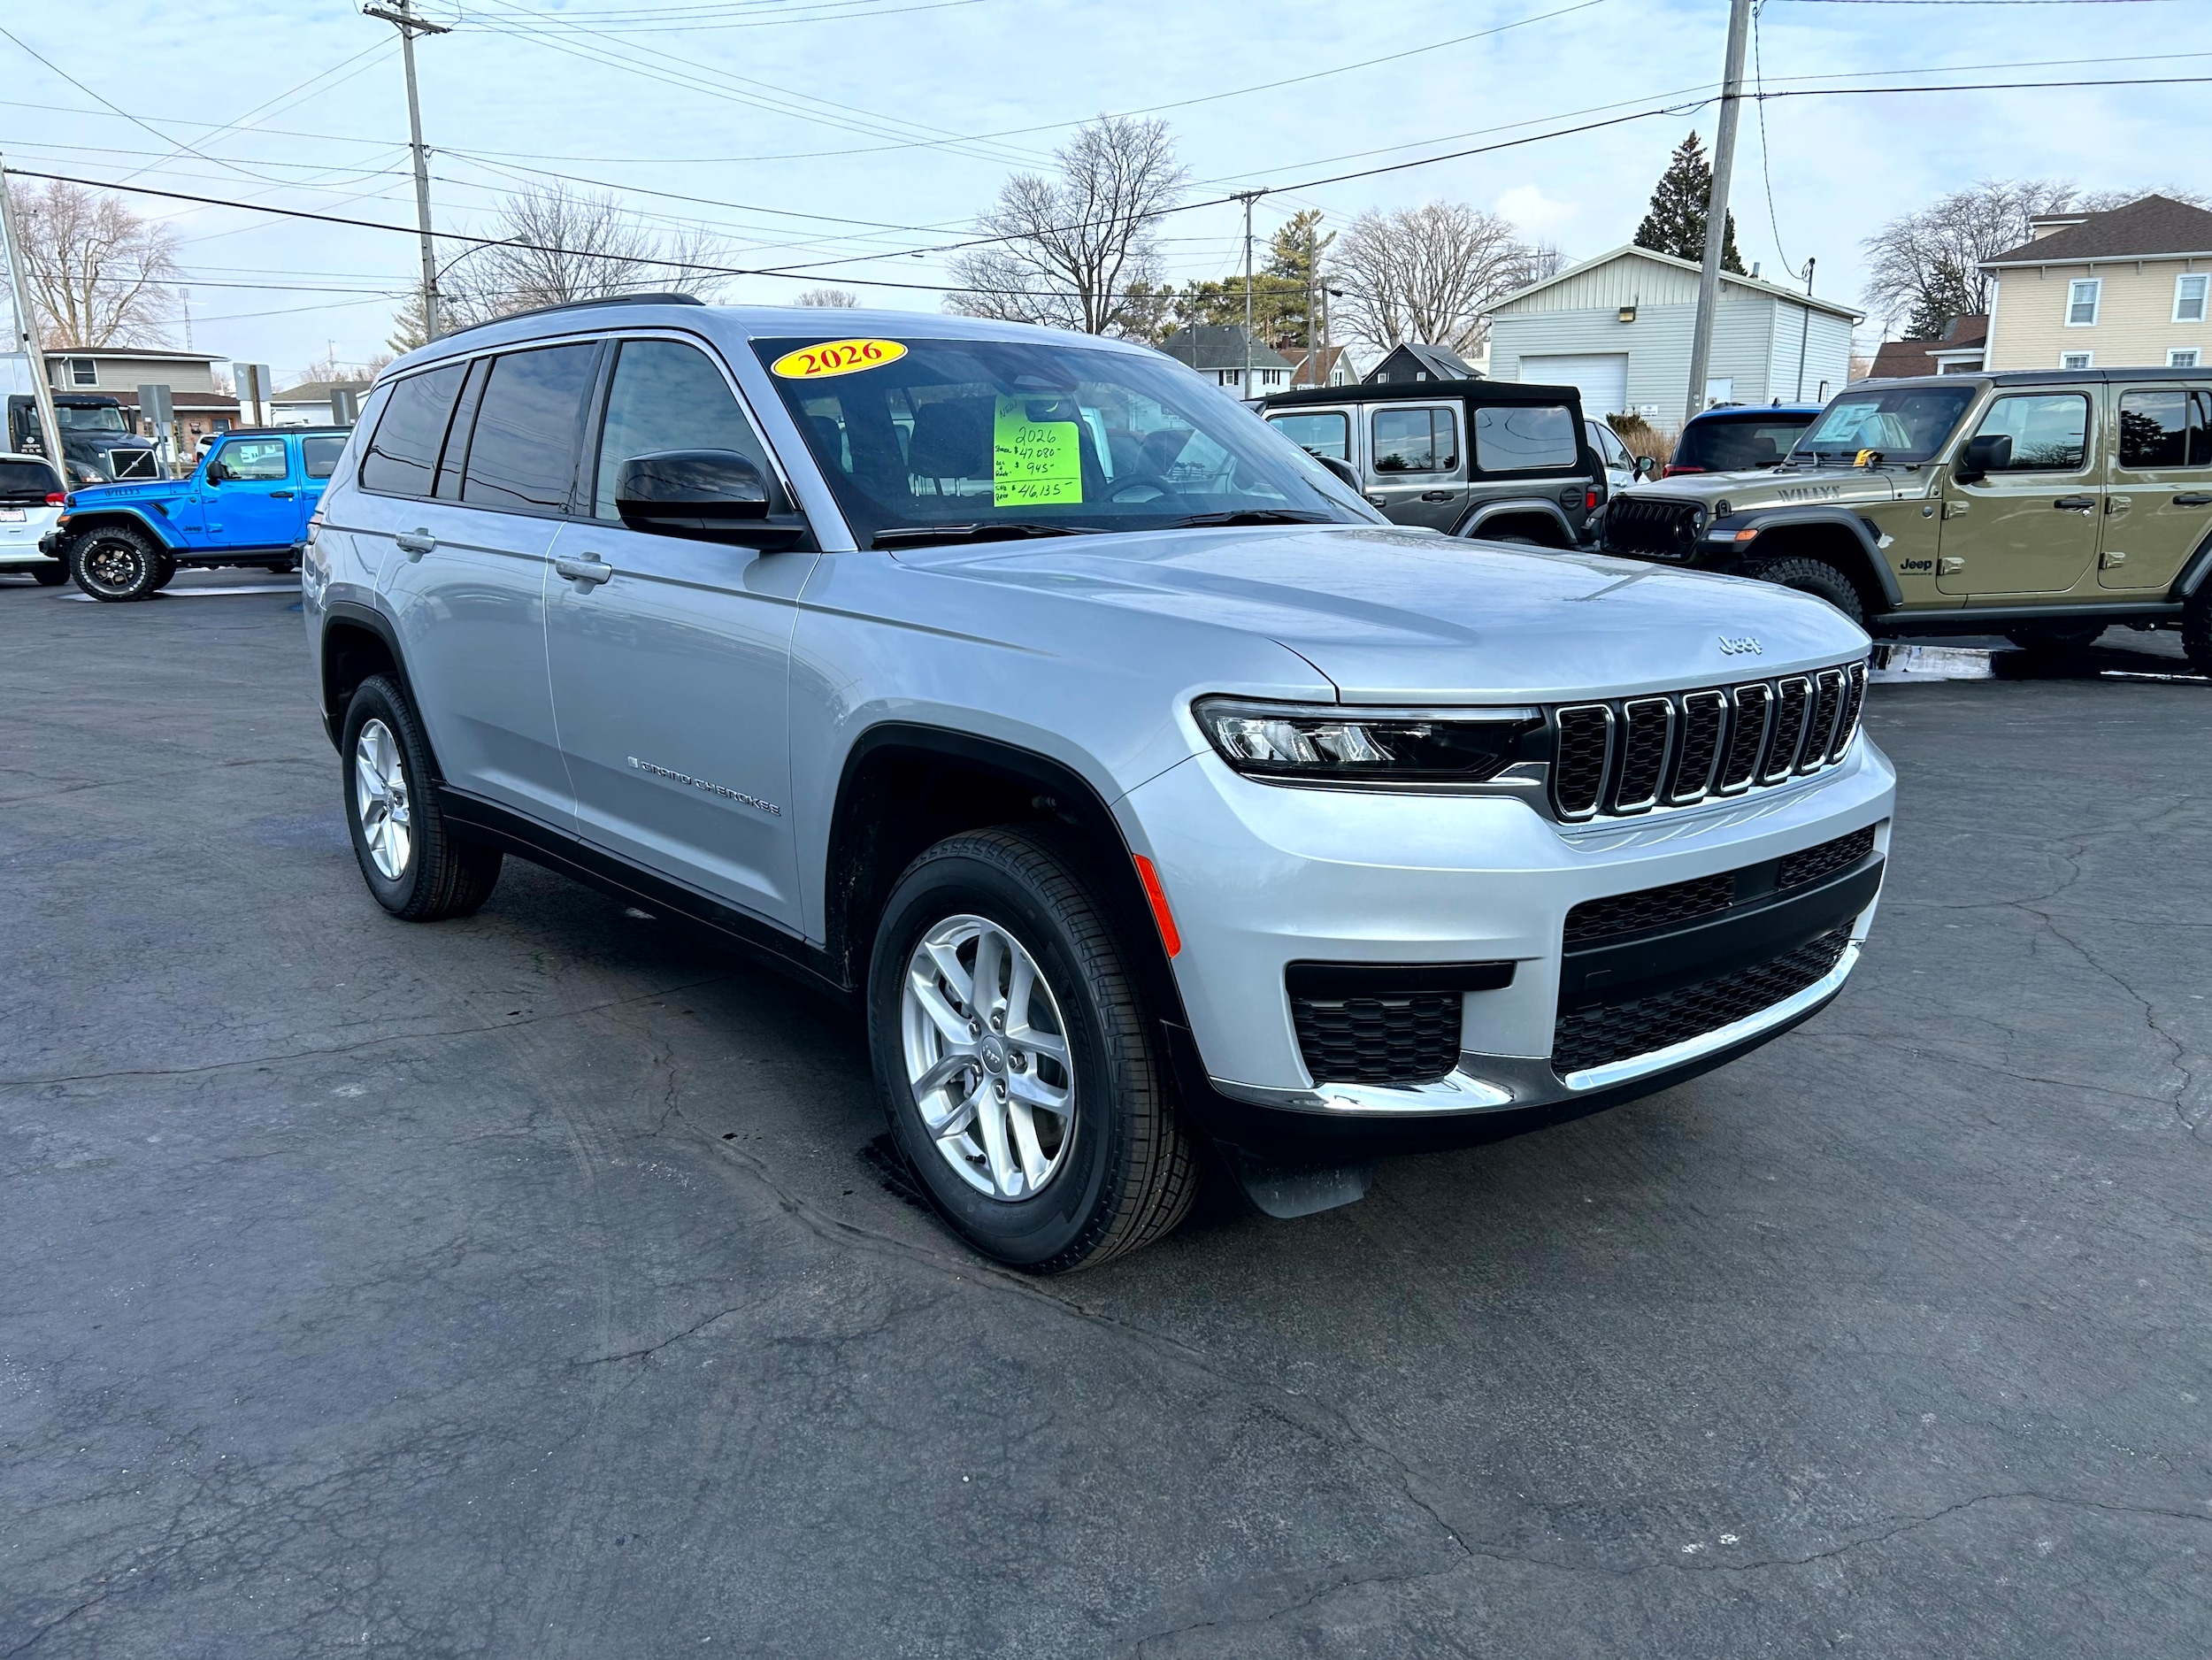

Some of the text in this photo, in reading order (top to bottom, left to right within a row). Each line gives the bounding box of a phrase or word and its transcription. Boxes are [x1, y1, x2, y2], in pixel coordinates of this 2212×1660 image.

[798, 342, 882, 375] 2026
[999, 399, 1018, 419] NEW
[1015, 426, 1056, 445] 2026
[104, 488, 141, 497] WILLYS
[1777, 486, 1840, 503] WILLYS
[1900, 557, 1932, 571] Jeep
[1718, 635, 1763, 656] Jeep
[641, 761, 781, 817] GRAND CHEROKEE
[1067, 998, 1095, 1122] MICHELIN
